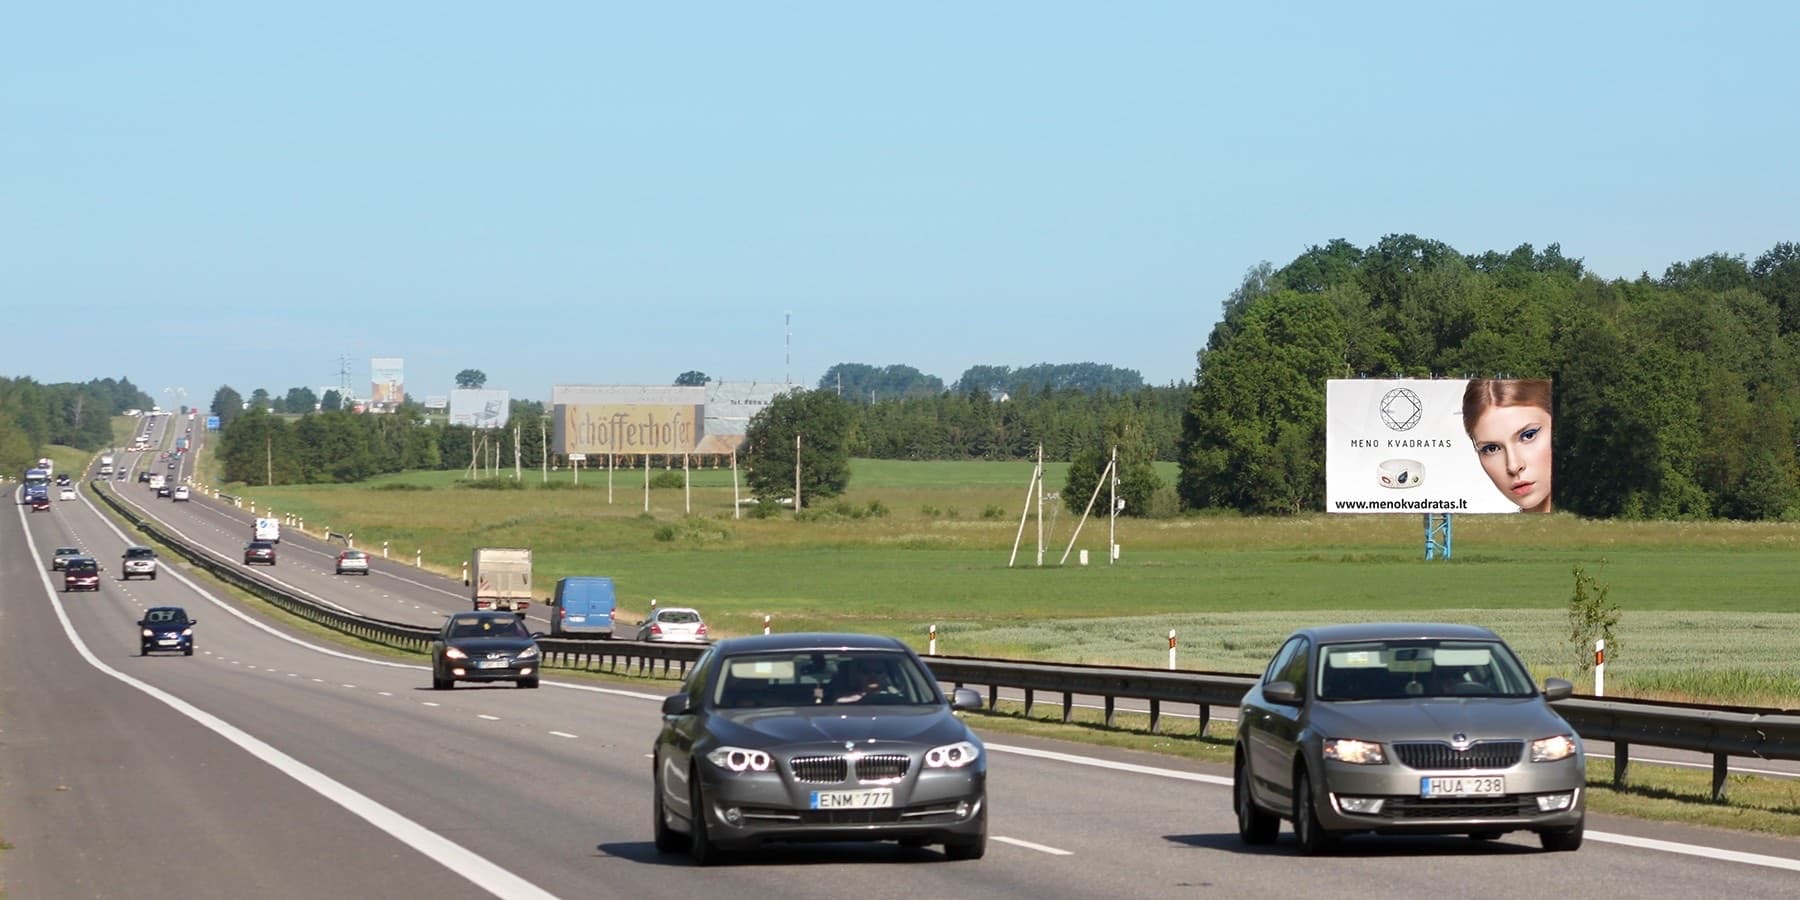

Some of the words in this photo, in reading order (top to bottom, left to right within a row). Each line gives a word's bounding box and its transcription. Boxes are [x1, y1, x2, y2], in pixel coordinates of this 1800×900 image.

[568, 404, 690, 451] Schöfferhofer
[1351, 439, 1379, 448] MENO
[1387, 439, 1452, 448] KVADRATAS
[1335, 498, 1468, 509] www.menokvadratas.lt
[1431, 779, 1464, 793] HUA
[1474, 779, 1502, 792] 238
[820, 793, 853, 807] ENM
[863, 792, 890, 806] 777
